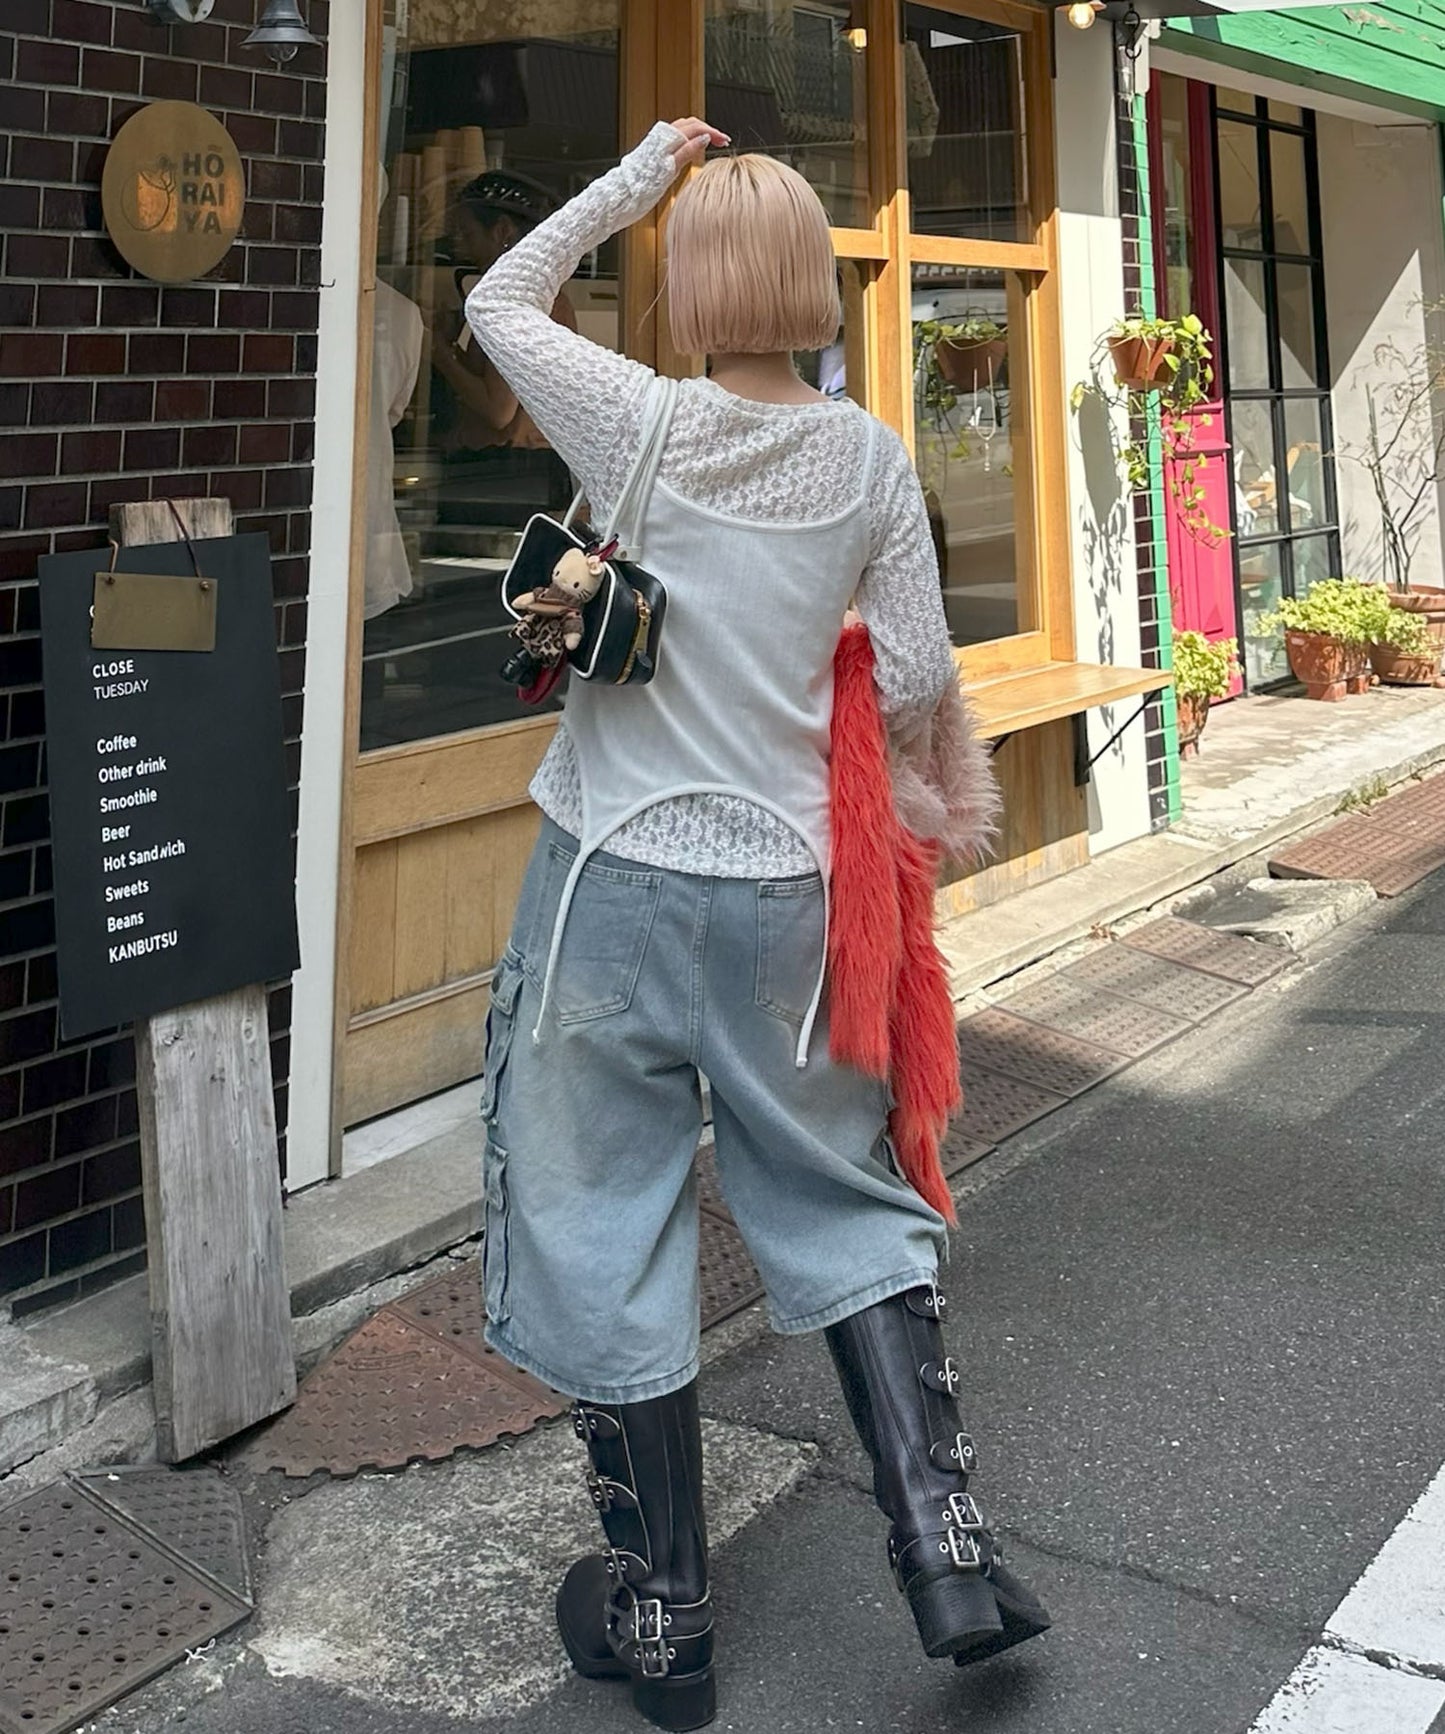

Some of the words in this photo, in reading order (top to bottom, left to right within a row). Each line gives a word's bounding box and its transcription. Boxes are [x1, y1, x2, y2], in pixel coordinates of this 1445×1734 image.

[182, 182, 225, 207] RAI
[184, 210, 222, 235] YA
[92, 659, 135, 679] CLOSE
[93, 678, 150, 700] TUESDAY
[96, 734, 137, 754] Coffee
[98, 764, 134, 784] Other
[135, 755, 167, 776] drink
[99, 787, 158, 813] Smoothie
[101, 824, 131, 843] Beer
[103, 853, 127, 873] Hot
[128, 839, 186, 867] Sandwich
[105, 879, 150, 903] Sweets
[107, 911, 145, 933] Beans
[108, 929, 178, 964] KANBUTSU
